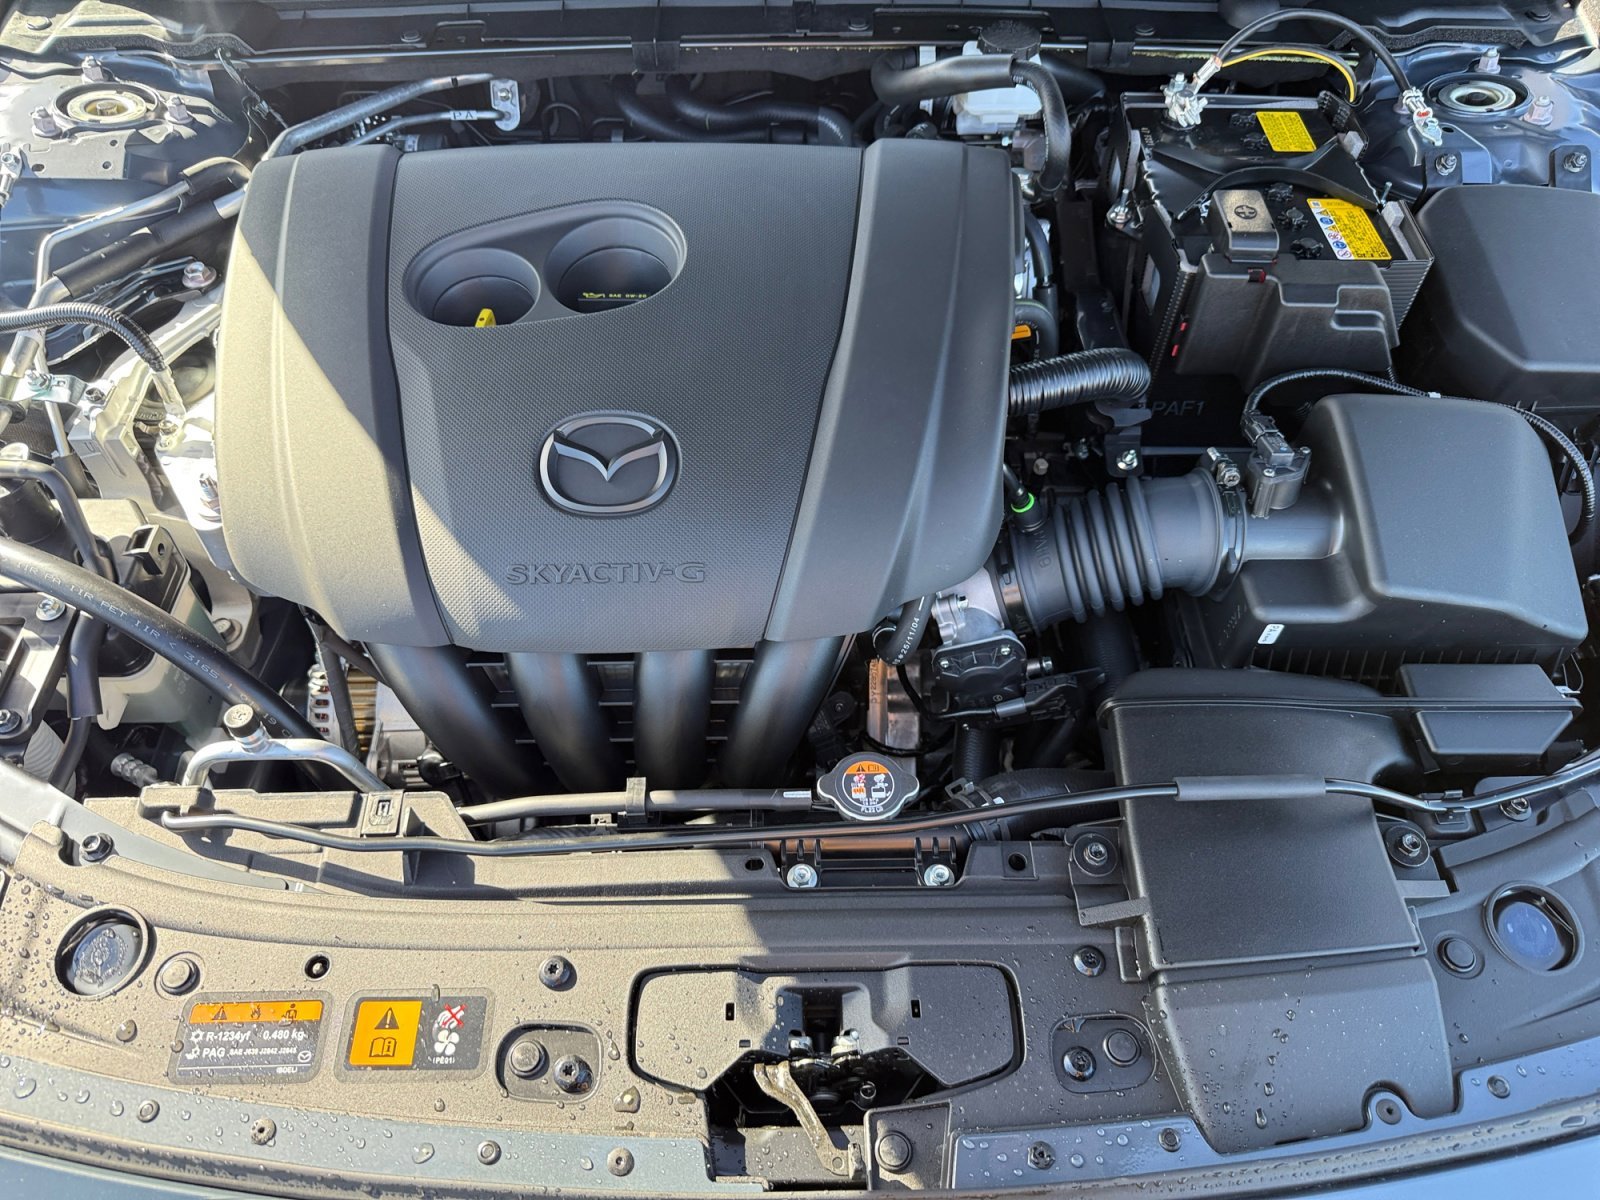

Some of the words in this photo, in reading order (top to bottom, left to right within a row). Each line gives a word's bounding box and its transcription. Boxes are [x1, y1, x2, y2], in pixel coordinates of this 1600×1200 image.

[1152, 400, 1205, 416] PAF1
[506, 562, 706, 585] SKYACTIV-G
[100, 600, 128, 618] PET
[183, 651, 220, 680] 3165
[205, 1030, 251, 1042] R-1234yf
[262, 1030, 289, 1041] 0.480
[291, 1029, 305, 1041] kg
[202, 1047, 226, 1058] PAG
